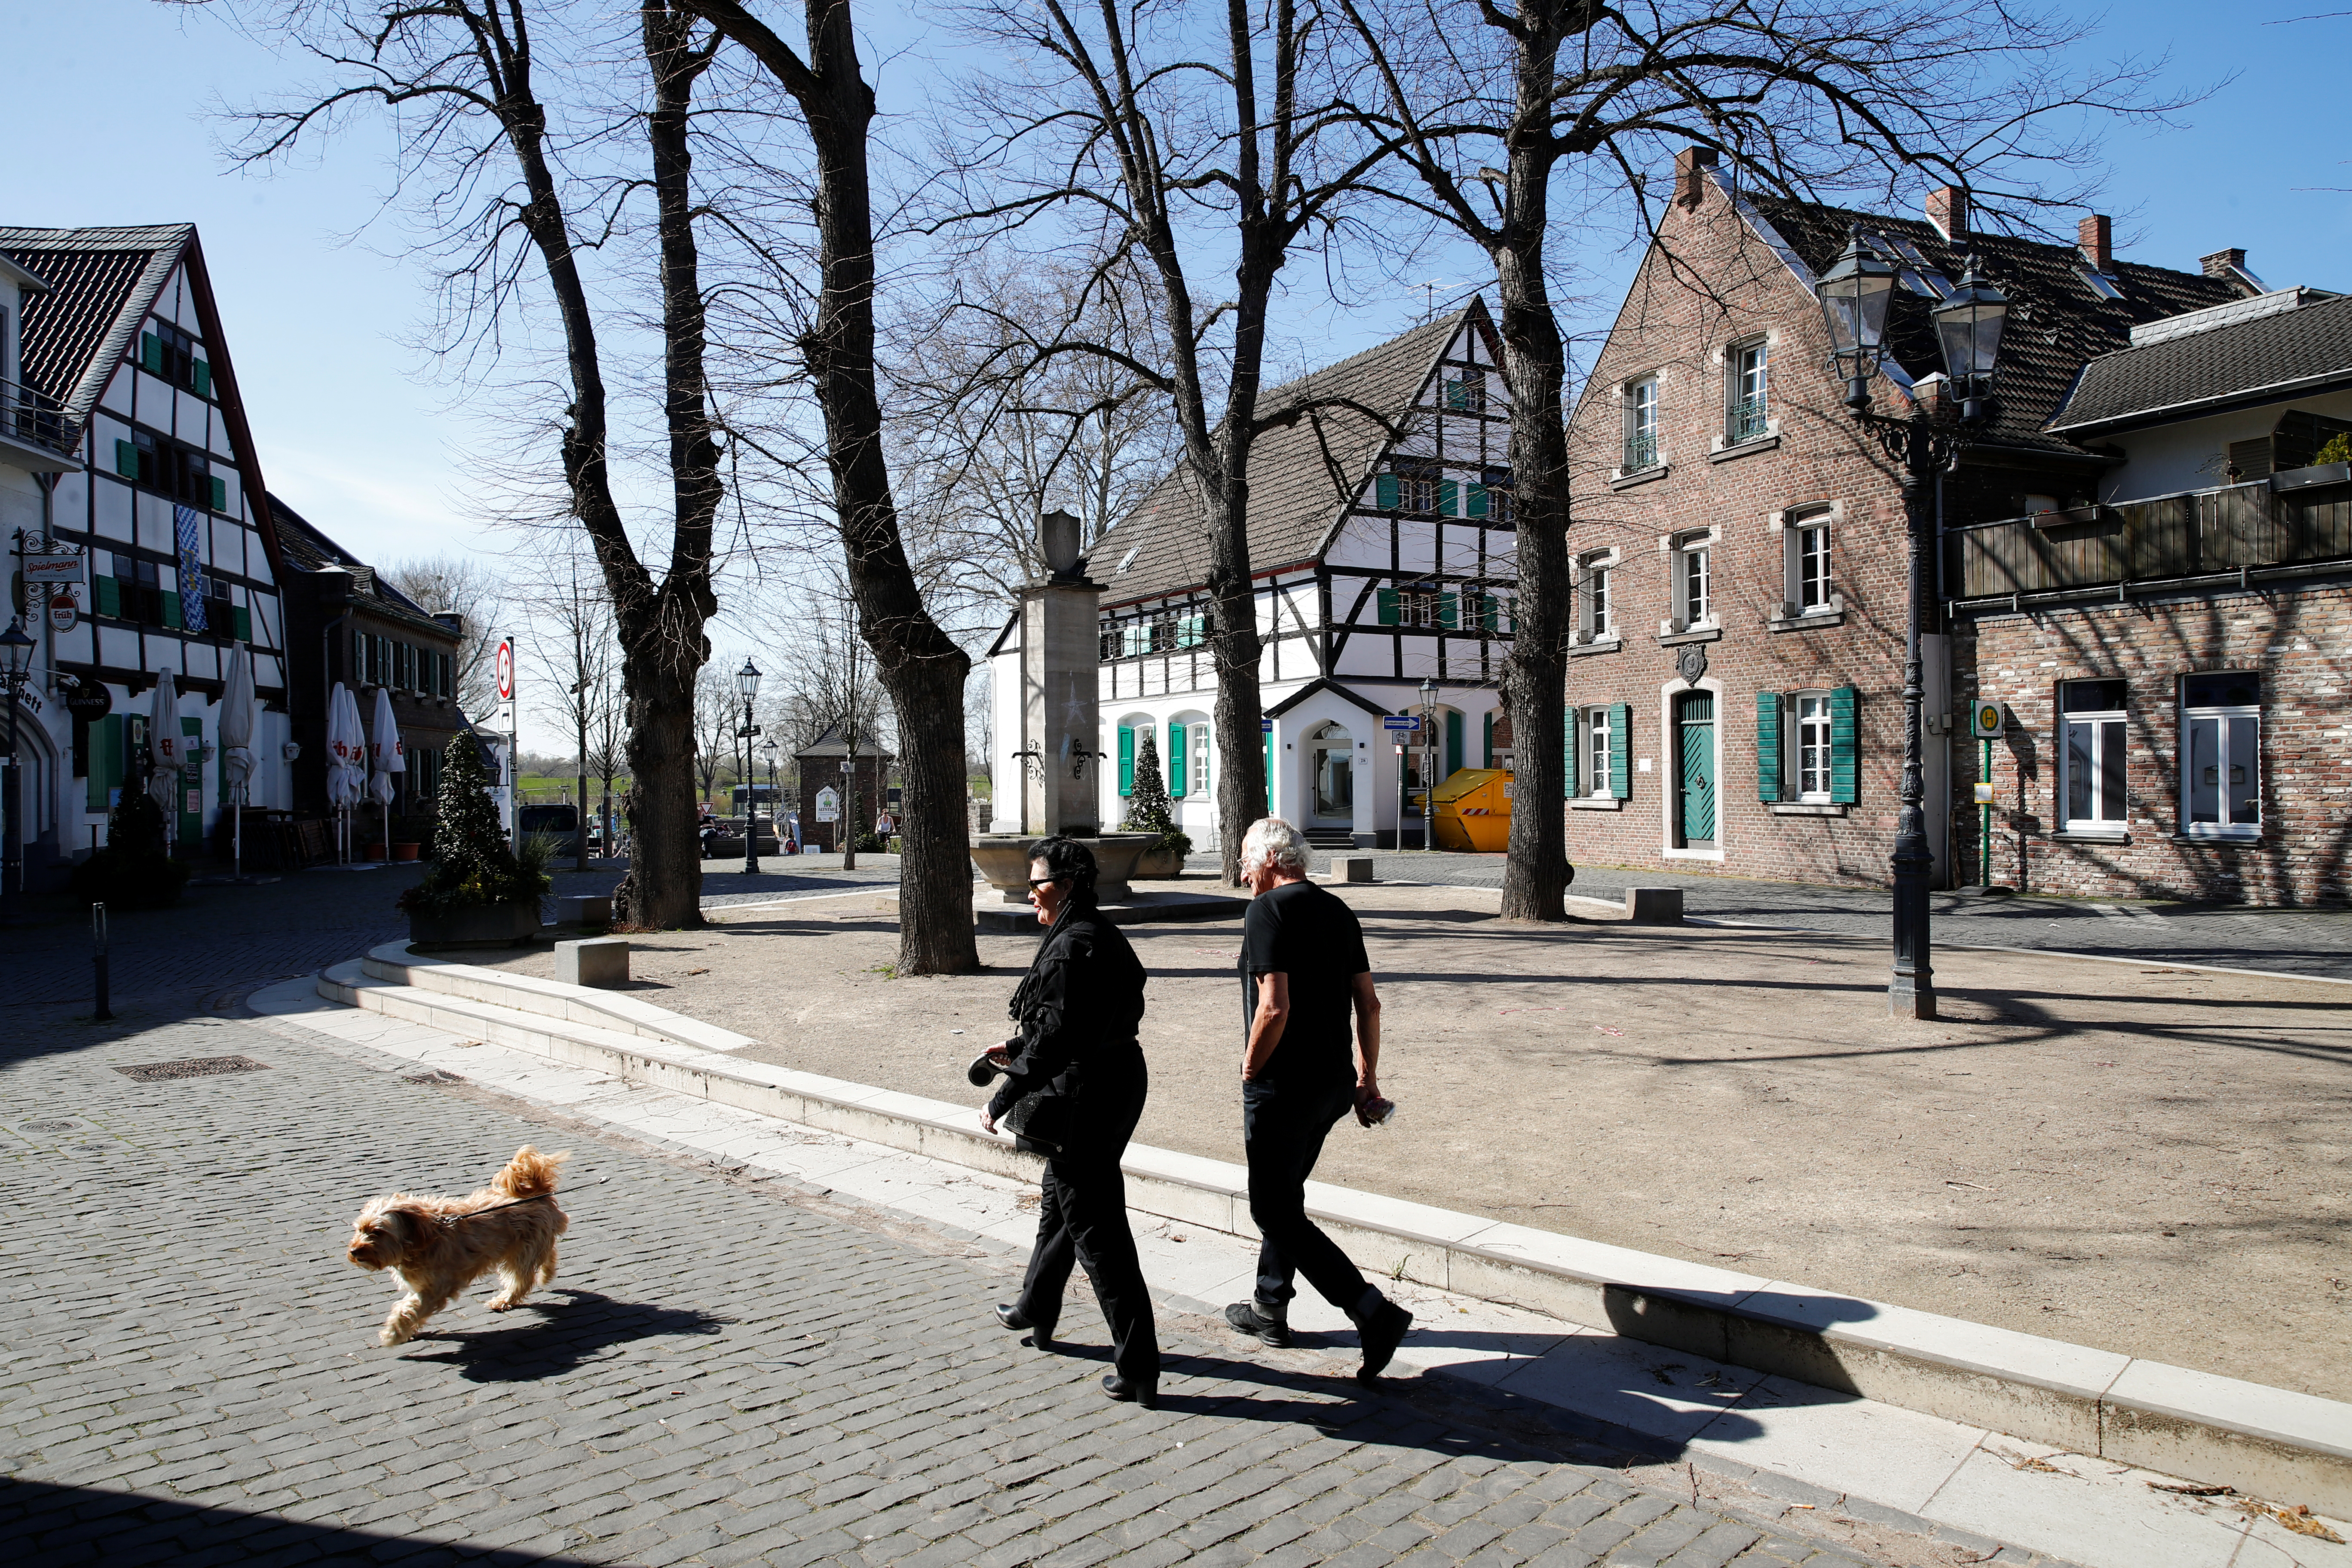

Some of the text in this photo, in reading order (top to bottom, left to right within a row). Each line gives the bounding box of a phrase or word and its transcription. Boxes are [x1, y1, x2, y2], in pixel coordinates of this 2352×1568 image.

[27, 560, 79, 574] Spielmann
[70, 697, 104, 705] GUINNESS
[1985, 711, 1993, 726] H
